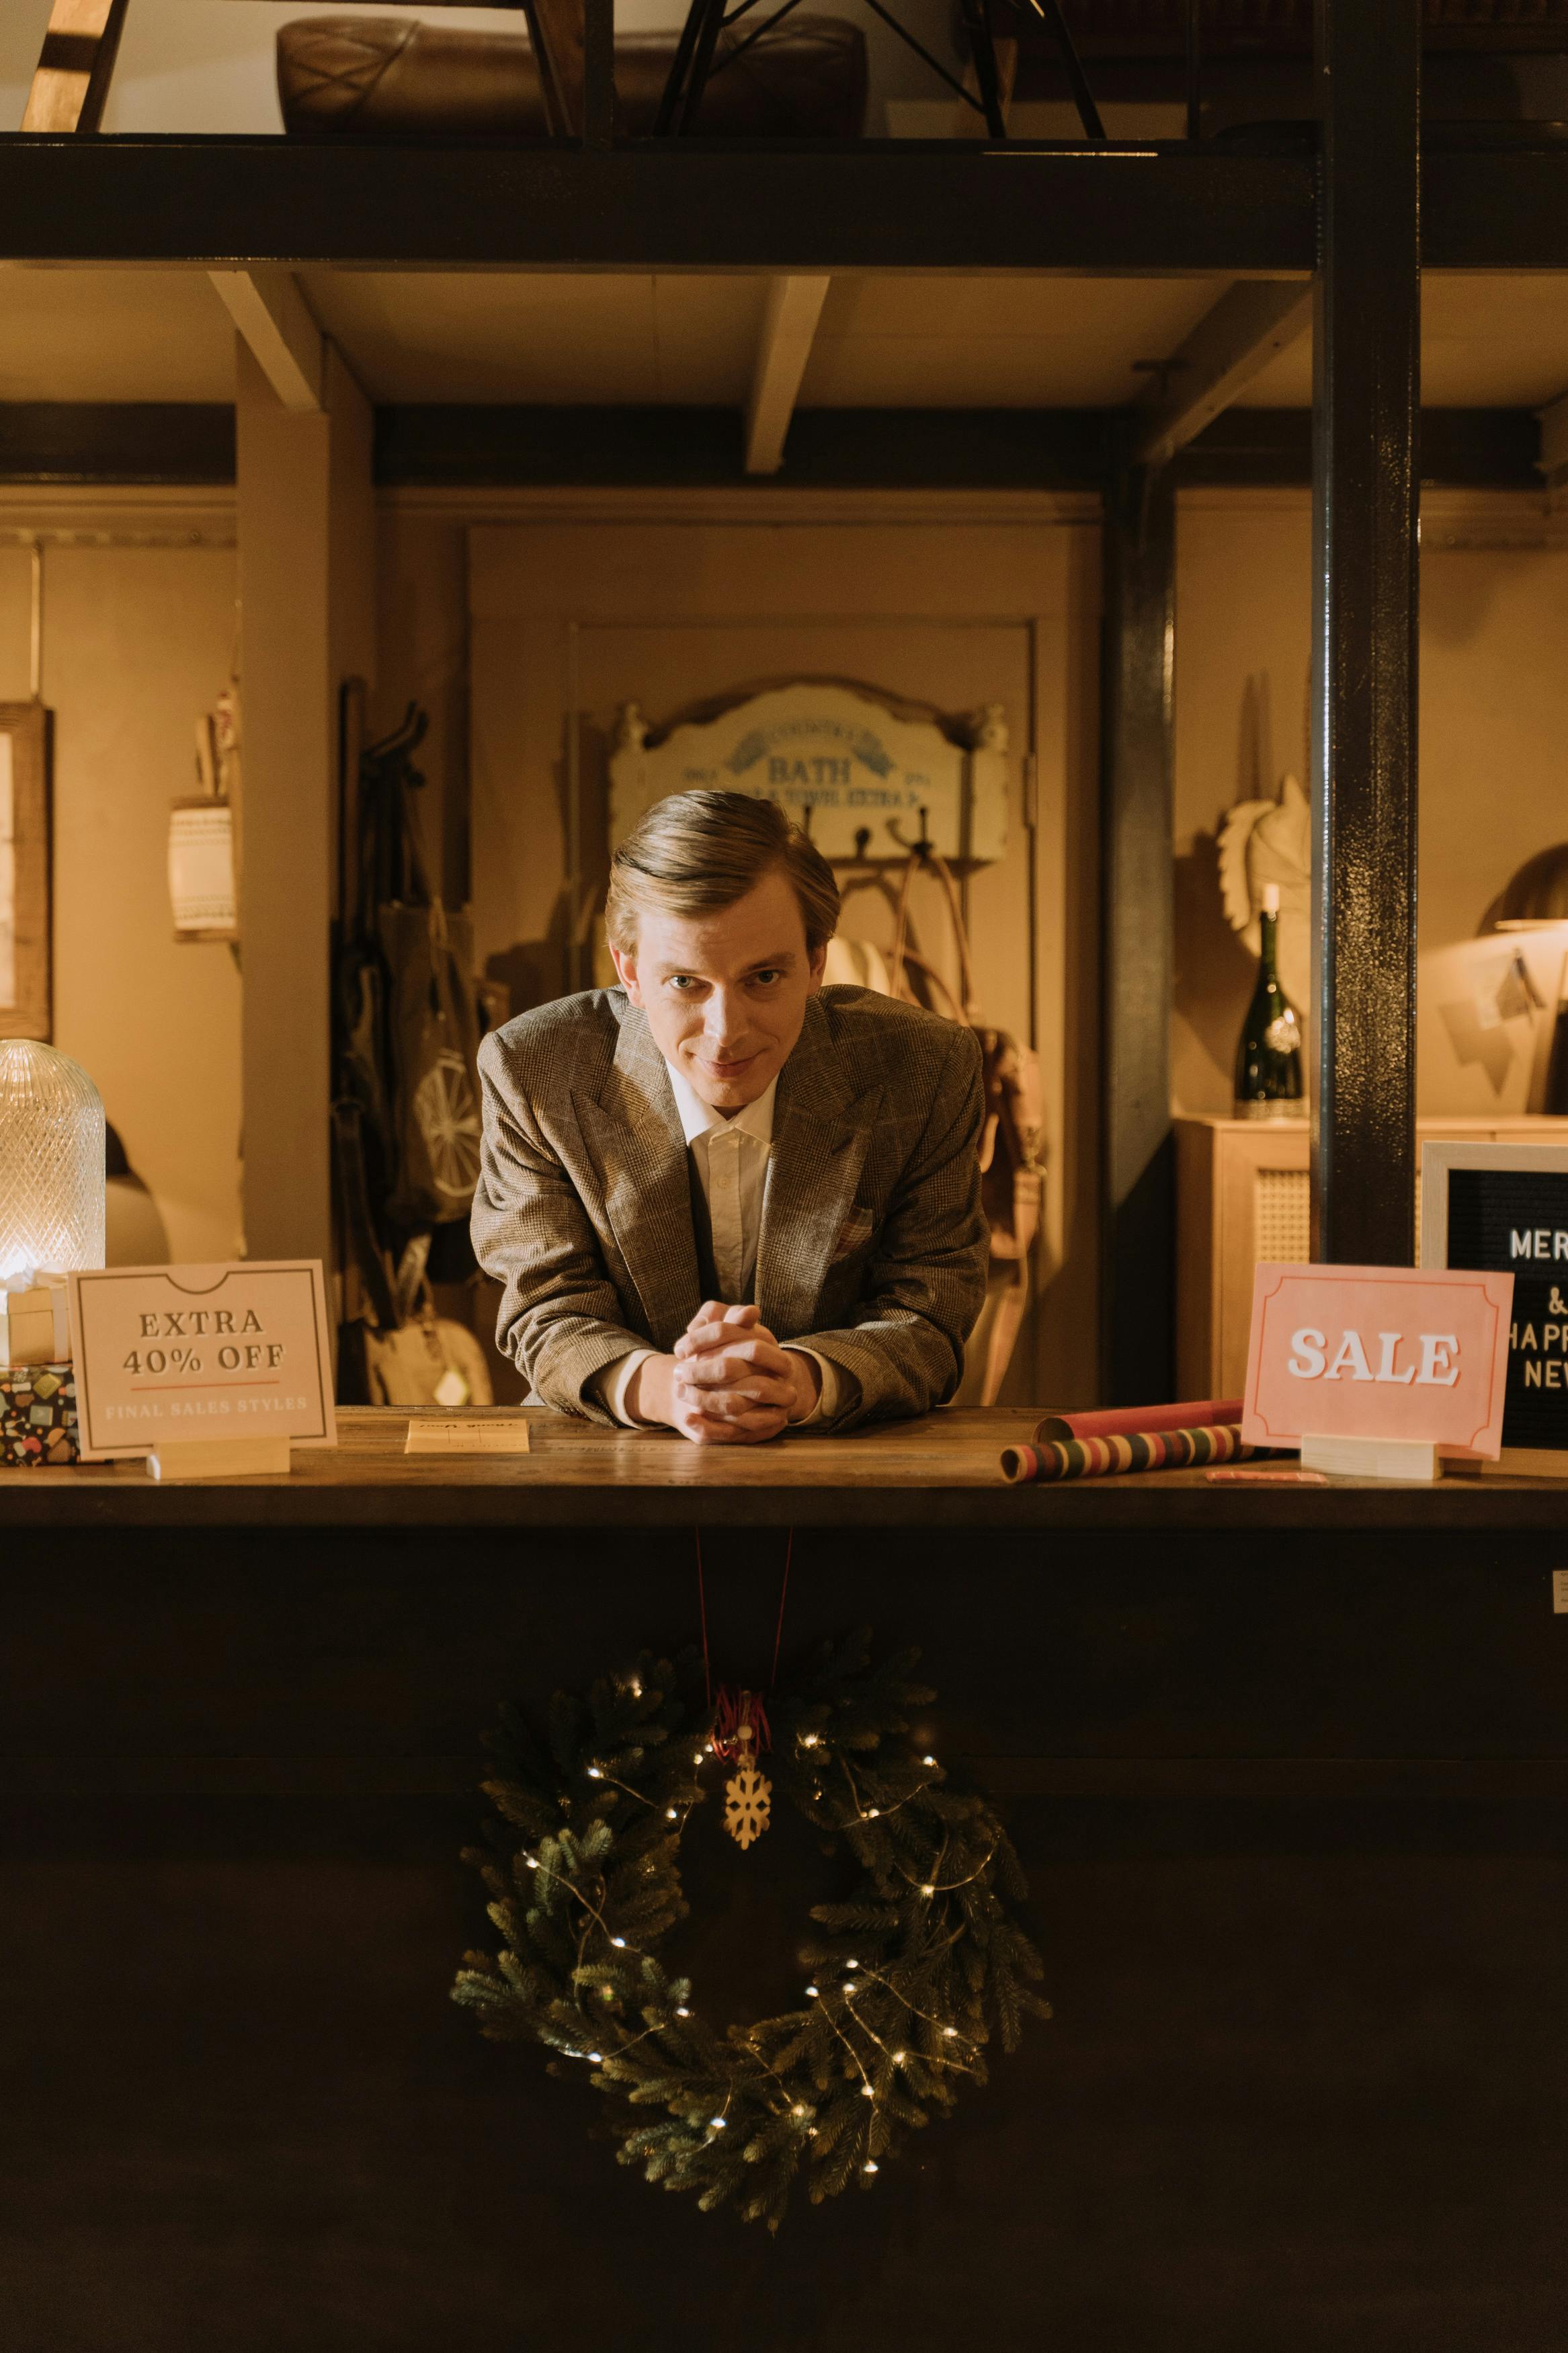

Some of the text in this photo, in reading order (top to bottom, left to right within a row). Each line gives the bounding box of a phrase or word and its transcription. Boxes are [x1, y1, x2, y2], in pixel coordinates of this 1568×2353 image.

[768, 755, 852, 785] BATH
[1510, 1229, 1568, 1260] MER
[1549, 1286, 1568, 1315] &
[139, 1310, 265, 1339] EXTRA
[122, 1344, 286, 1375] 40% OFF
[1288, 1328, 1461, 1388] SALE
[1524, 1360, 1568, 1388] NE
[106, 1396, 308, 1420] FINAL SALES STYLES
